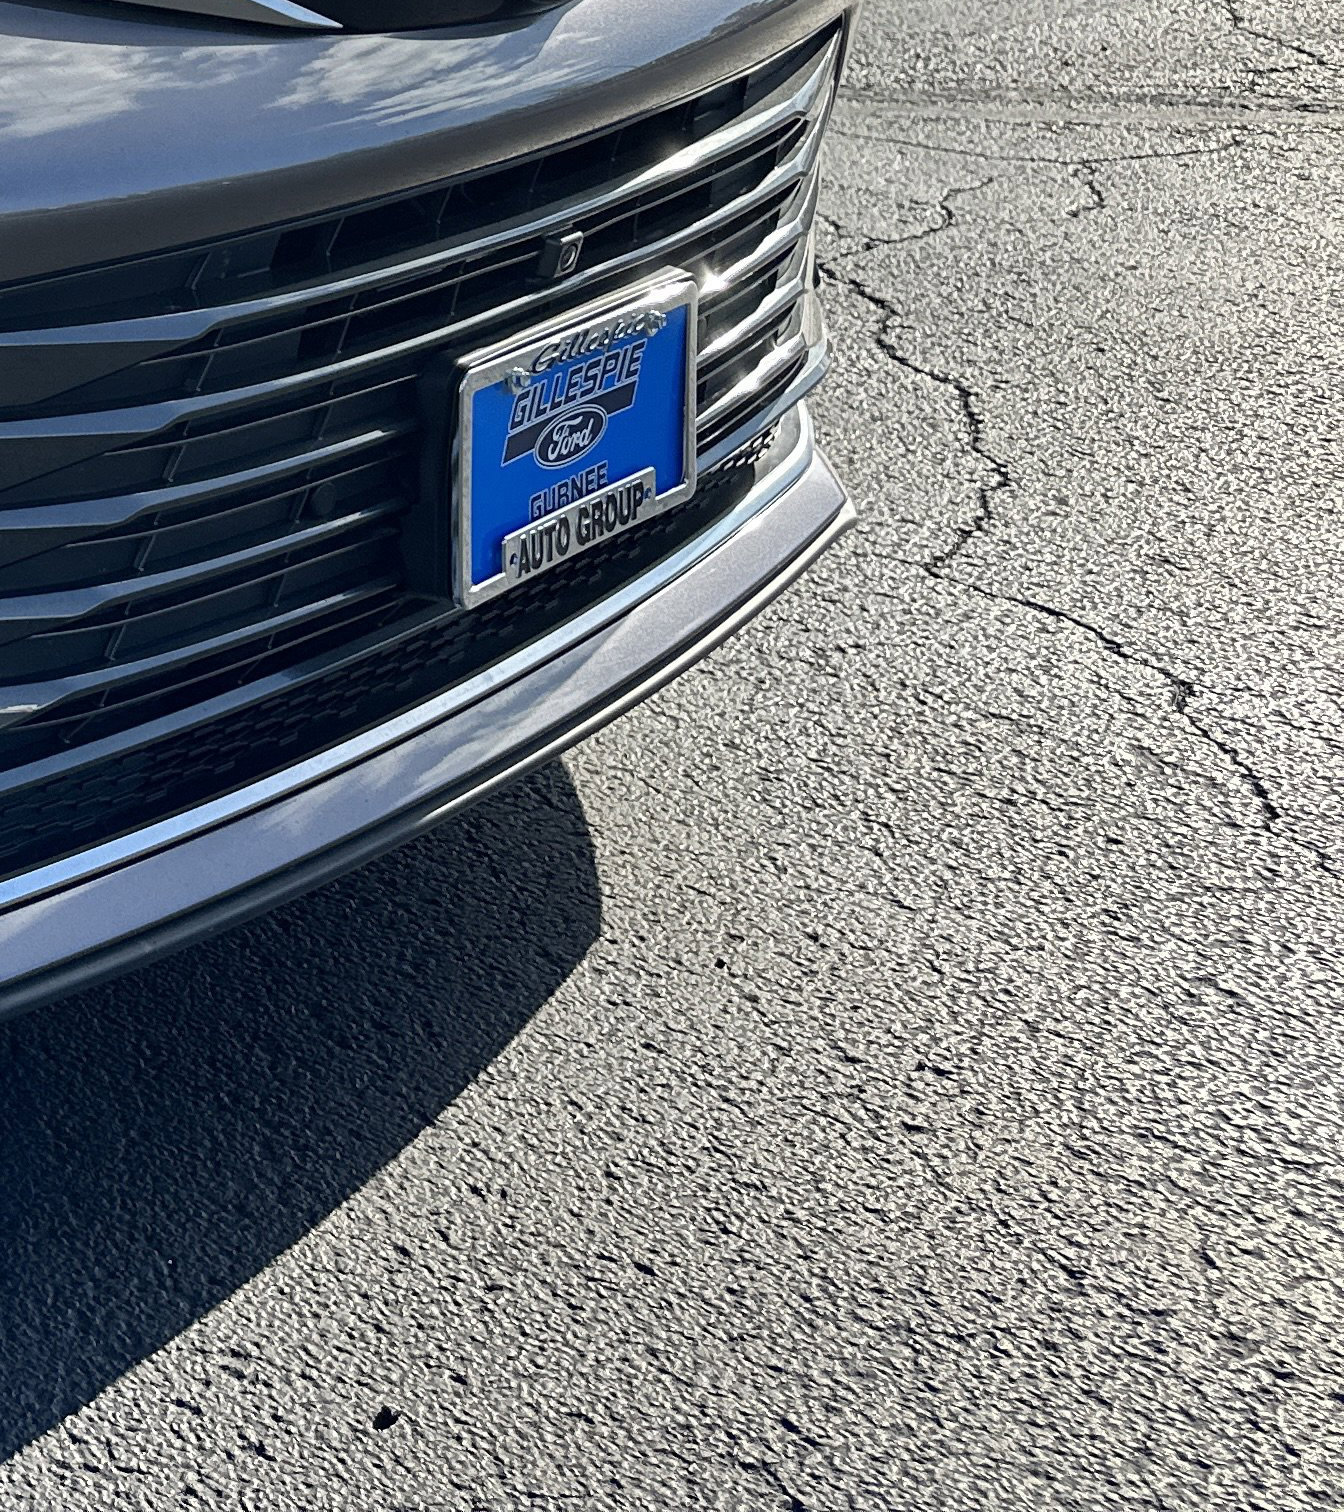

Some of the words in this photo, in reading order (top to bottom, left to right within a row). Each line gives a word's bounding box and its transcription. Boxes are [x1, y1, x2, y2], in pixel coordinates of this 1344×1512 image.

[510, 340, 646, 431] GILLESPIE
[548, 415, 594, 460] Ford
[529, 461, 608, 520] GURNEE
[516, 514, 570, 578] AUTO
[576, 479, 644, 546] GROUP
